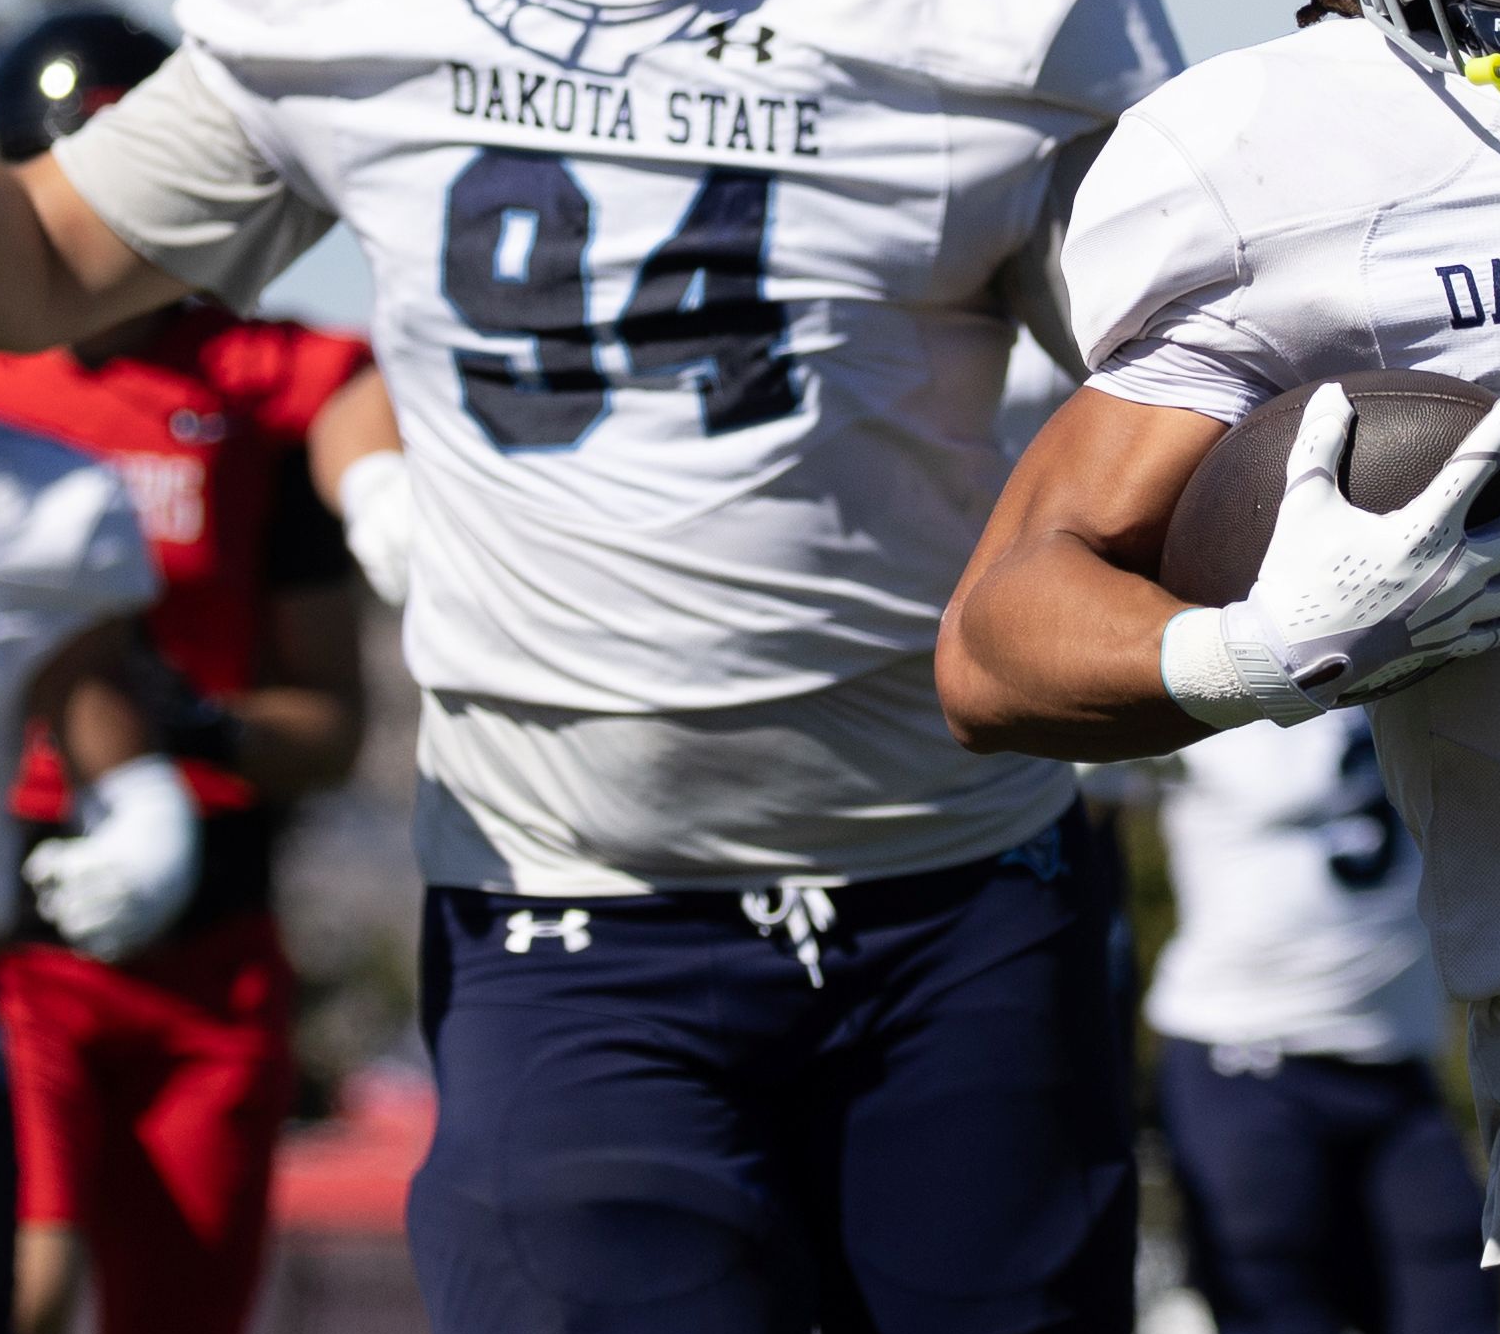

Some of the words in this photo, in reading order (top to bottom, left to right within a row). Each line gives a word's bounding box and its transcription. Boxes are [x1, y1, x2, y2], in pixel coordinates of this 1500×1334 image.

[450, 60, 636, 142] DAKOTA
[667, 90, 822, 157] STATE
[441, 143, 806, 457] 94
